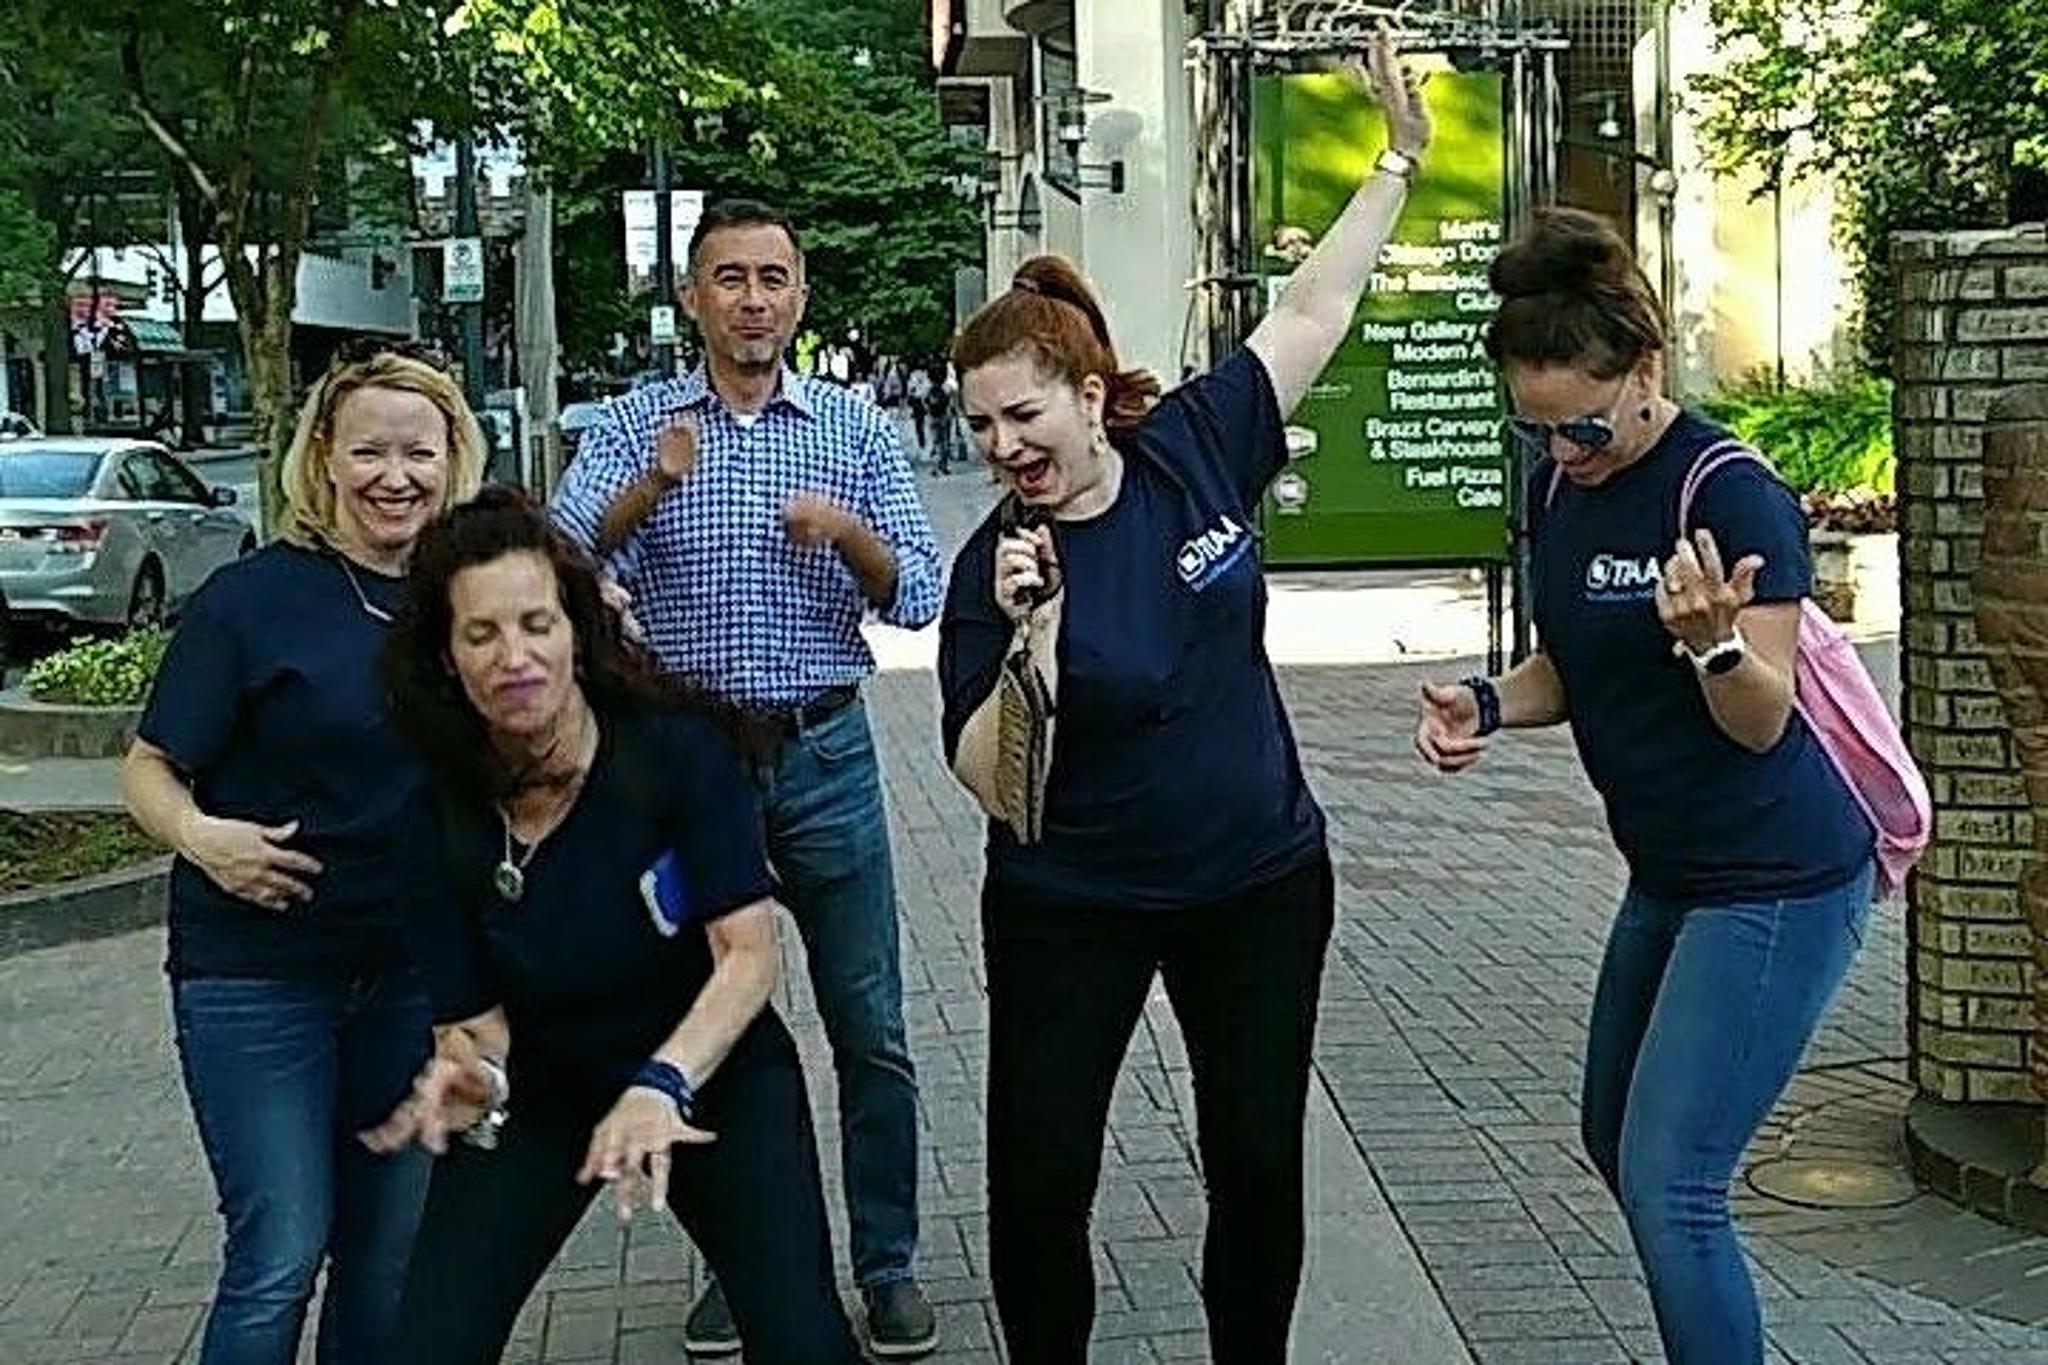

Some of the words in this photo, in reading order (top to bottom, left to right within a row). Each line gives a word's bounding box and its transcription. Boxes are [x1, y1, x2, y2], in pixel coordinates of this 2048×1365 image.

[1370, 272, 1405, 292] The
[1363, 323, 1406, 341] New
[1410, 321, 1477, 342] Gallery
[1393, 342, 1469, 362] Modern
[1387, 367, 1496, 390] Bernardin's
[1390, 390, 1497, 411] Restaurant
[1366, 418, 1422, 438] Brazz
[1425, 417, 1505, 438] Carvery
[1370, 440, 1386, 459] &
[1389, 438, 1502, 460] Steakhouse
[1406, 466, 1448, 487] Fuel
[1450, 466, 1502, 485] Pizza
